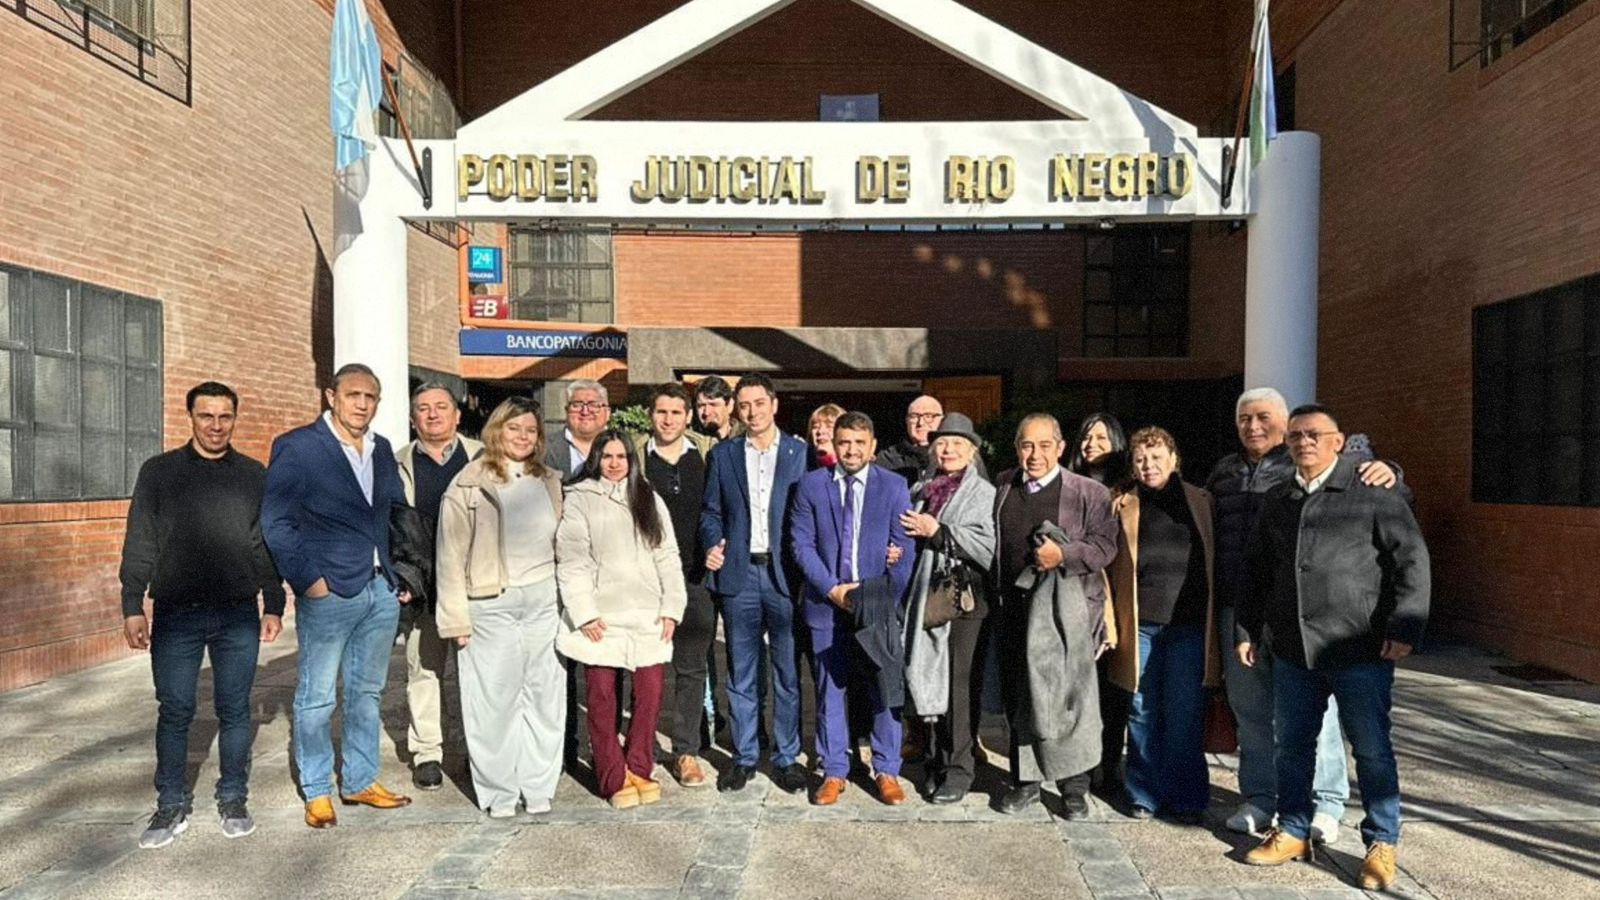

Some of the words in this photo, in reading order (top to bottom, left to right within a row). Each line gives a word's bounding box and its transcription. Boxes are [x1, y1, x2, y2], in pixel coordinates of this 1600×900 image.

[457, 154, 598, 202] PODER
[630, 155, 825, 204] JUDICIAL
[856, 155, 910, 203] DE
[946, 154, 1015, 203] RIO
[1049, 152, 1193, 201] NEGRO
[473, 251, 492, 266] 24
